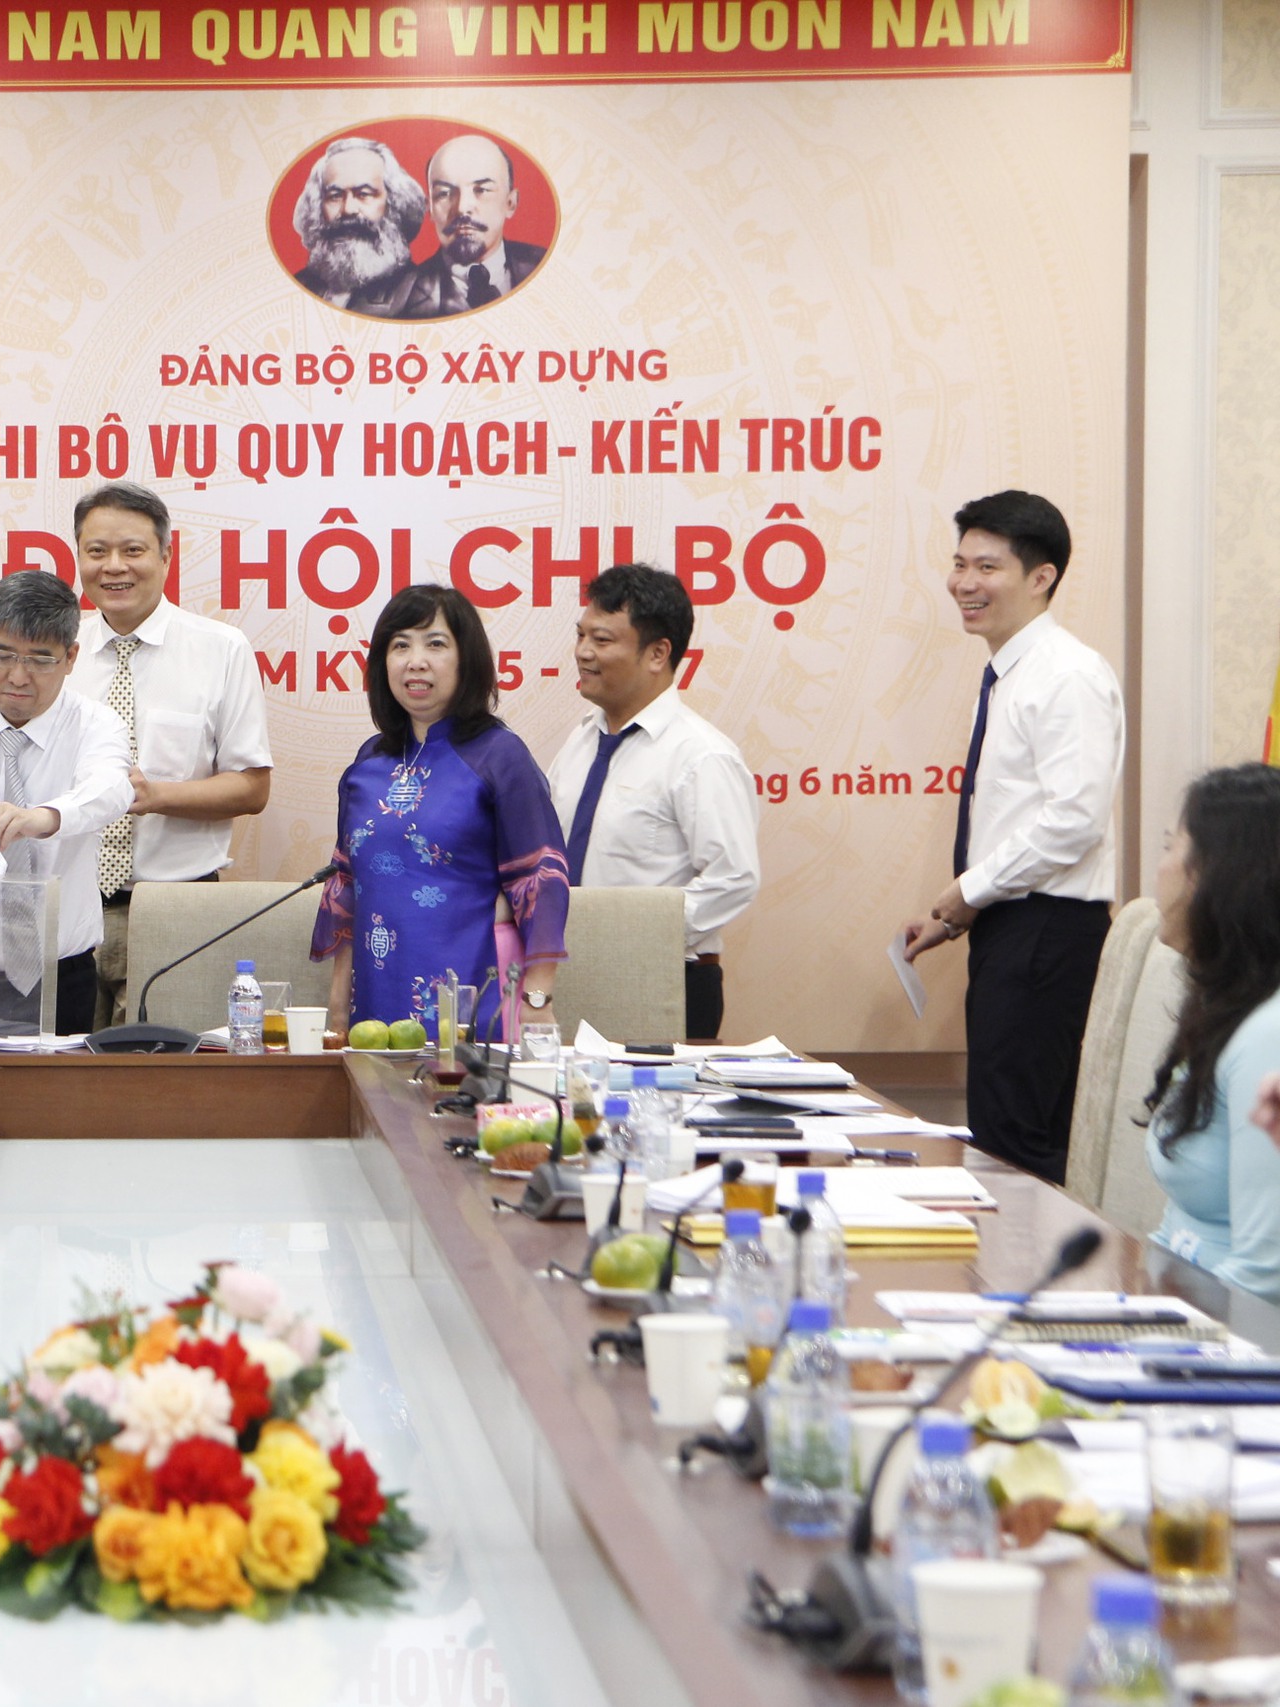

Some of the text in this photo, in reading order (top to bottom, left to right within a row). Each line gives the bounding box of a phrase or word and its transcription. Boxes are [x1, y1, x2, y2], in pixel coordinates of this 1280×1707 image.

[8, 10, 160, 61] NAM
[192, 7, 418, 65] QUANG
[448, 4, 607, 56] VINH
[160, 343, 668, 394] ĐẢNG BỘ BỘ XÂY DỰNG
[149, 423, 217, 490] VỤ
[238, 423, 344, 485] QUY
[363, 420, 548, 489] HOẠCH
[591, 400, 720, 475] KIẾN
[739, 405, 883, 474] TRÚC
[2, 530, 180, 611] ĐI
[220, 508, 412, 635] HỘI
[675, 502, 827, 632] BỘ
[799, 767, 821, 796] 6
[832, 765, 912, 795] năm
[923, 765, 967, 794] 20
